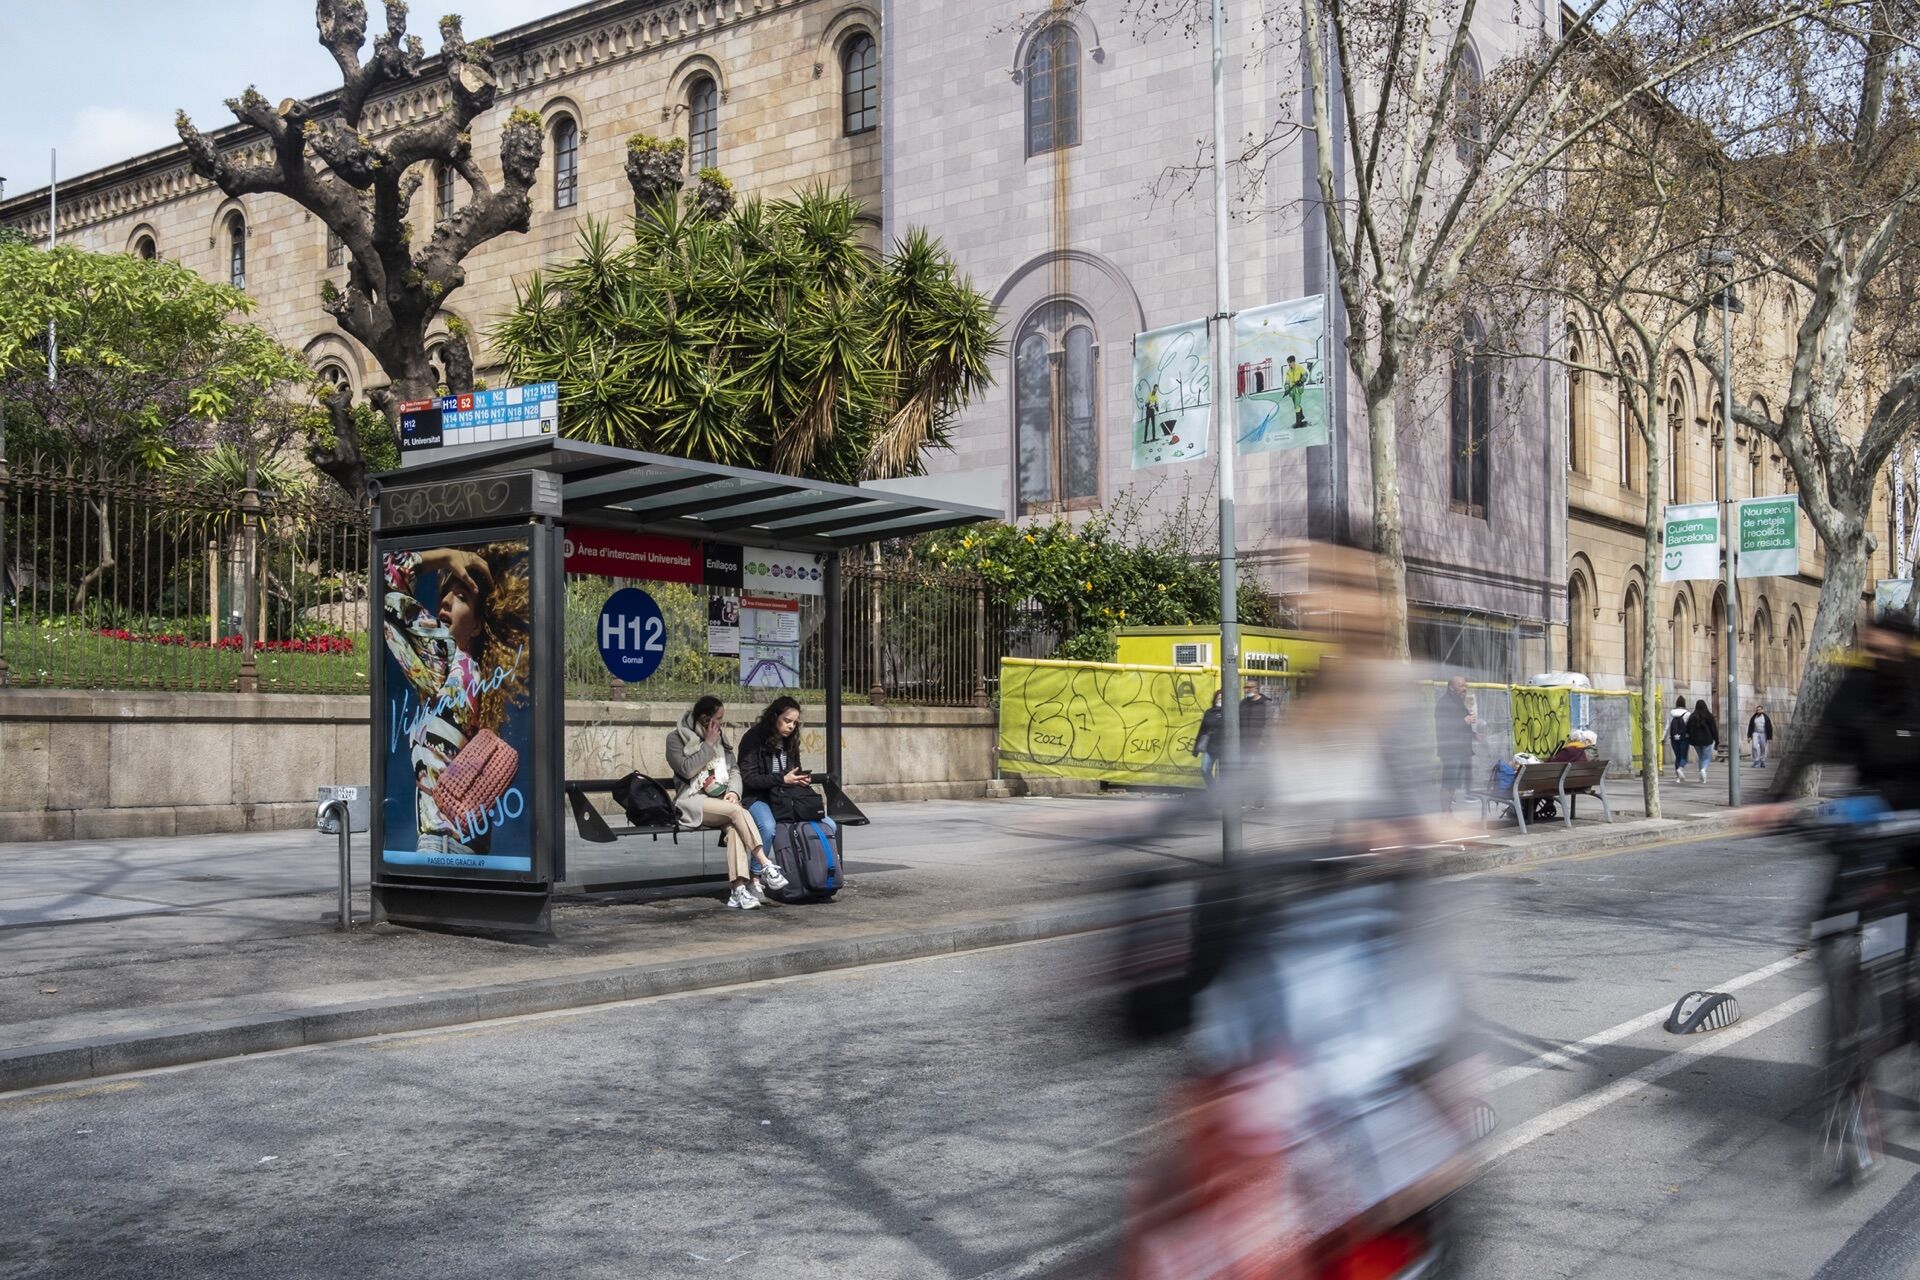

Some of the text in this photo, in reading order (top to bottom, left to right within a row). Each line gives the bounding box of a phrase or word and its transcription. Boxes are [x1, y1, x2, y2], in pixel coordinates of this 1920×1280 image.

[442, 400, 458, 410] H12
[461, 397, 471, 408] 52
[476, 395, 486, 404] N1
[492, 391, 504, 401] N2
[523, 388, 539, 398] N12
[540, 384, 556, 395] N13
[443, 414, 458, 423] N14
[459, 412, 473, 422] N15
[474, 410, 490, 420] N16
[491, 408, 506, 418] N17
[508, 406, 522, 417] N18
[524, 405, 539, 415] N28
[404, 419, 416, 428] H12
[412, 435, 441, 446] Universitat
[1743, 505, 1791, 517] Nou servei
[1743, 516, 1785, 528] de neteja
[1668, 522, 1704, 535] Cuidem
[1747, 527, 1785, 538] recollida
[1668, 533, 1714, 546] Barcelona
[1743, 537, 1791, 549] de residus
[578, 542, 598, 557] Àrea
[600, 547, 647, 562] d'intercanvi
[648, 552, 692, 567] Universitat
[706, 558, 738, 573] Enllaços
[602, 613, 664, 652] H12
[622, 655, 644, 665] Gornal
[1033, 732, 1067, 747] 2021
[427, 857, 446, 865] PASEO
[446, 858, 454, 866] DE
